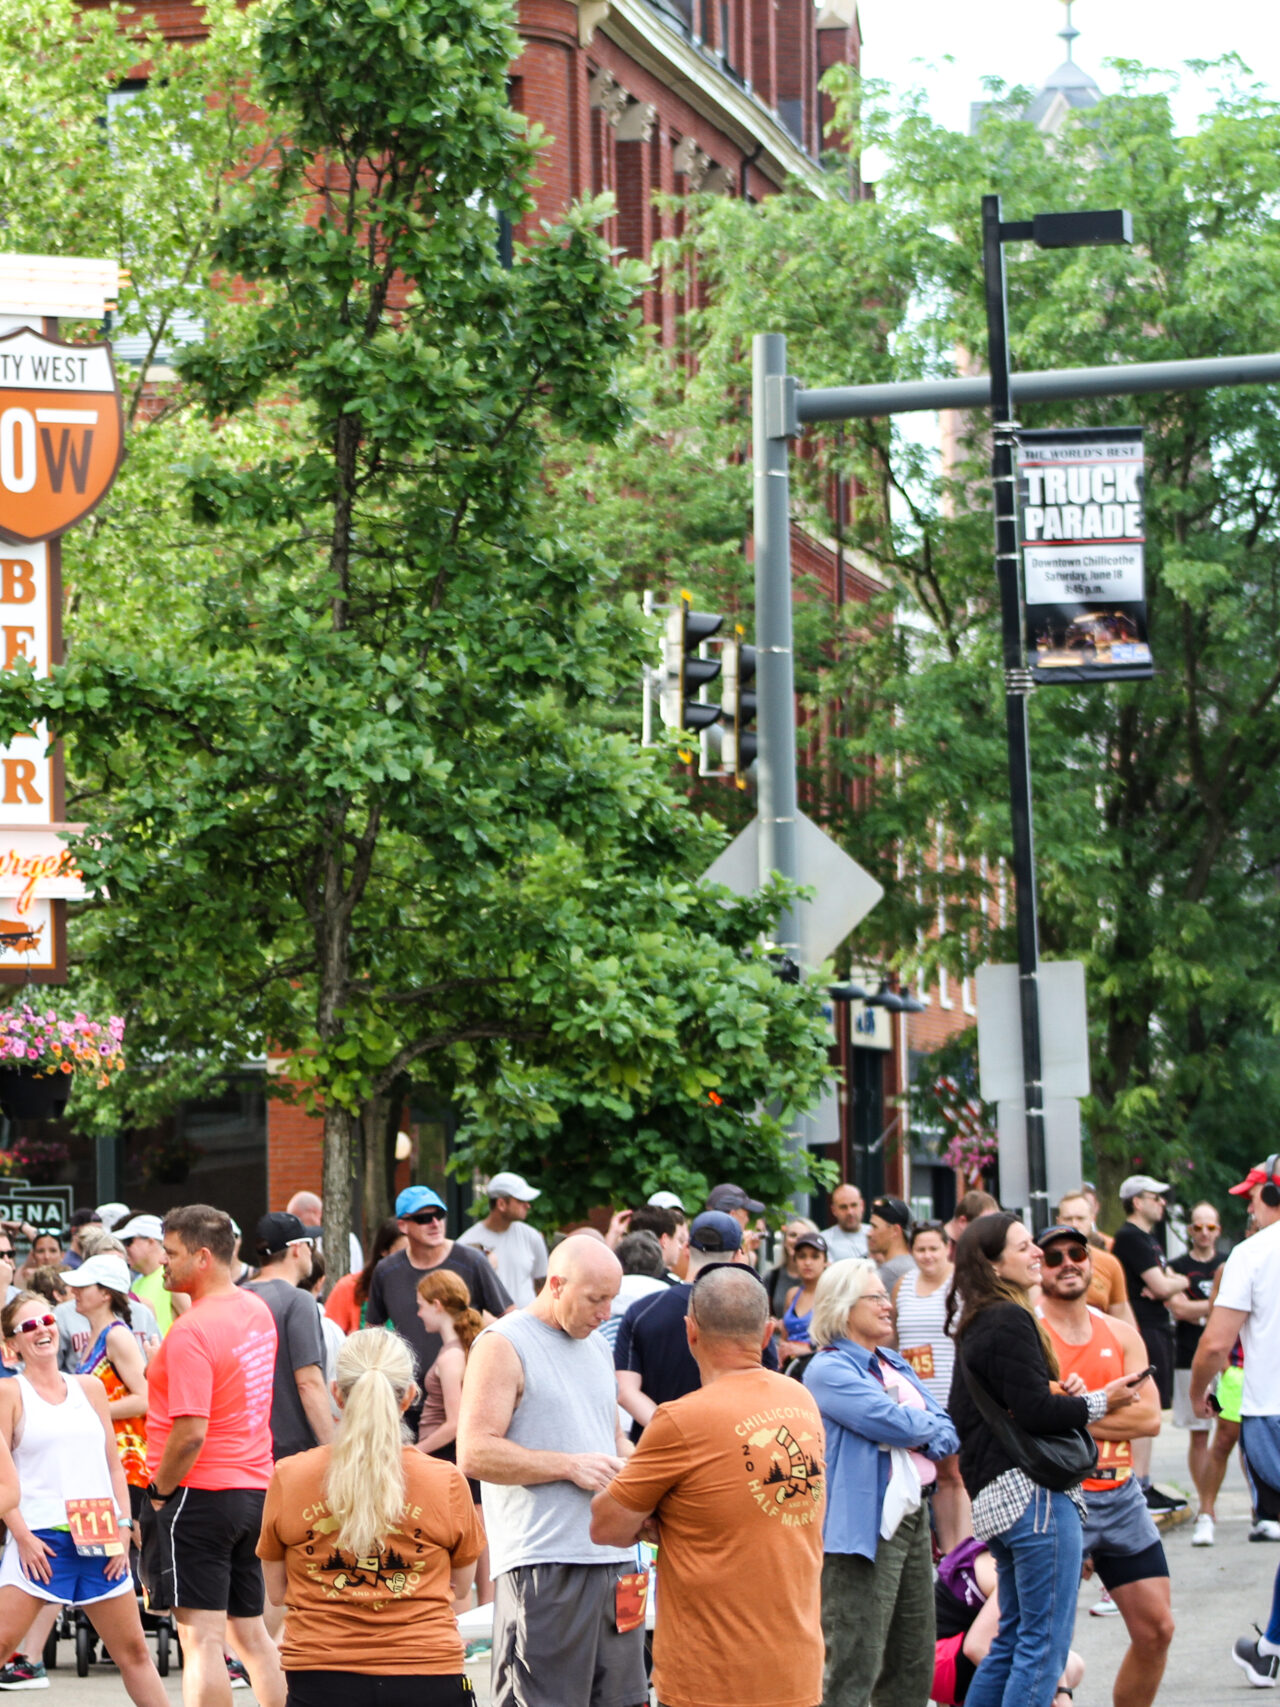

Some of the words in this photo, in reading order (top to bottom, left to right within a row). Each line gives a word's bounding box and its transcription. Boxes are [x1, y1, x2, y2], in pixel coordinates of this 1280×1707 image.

[30, 356, 88, 384] WEST
[1050, 447, 1103, 460] WORLD'S
[1106, 446, 1137, 458] BEST
[1023, 465, 1141, 505] TRUCK
[1024, 503, 1142, 541] PARADE
[1031, 557, 1082, 569] Downtown
[1082, 555, 1136, 568] Chillicothe
[1044, 570, 1088, 583] Saturday,
[1090, 568, 1112, 580] June
[747, 1478, 780, 1517] HALF
[70, 1510, 115, 1537] 111
